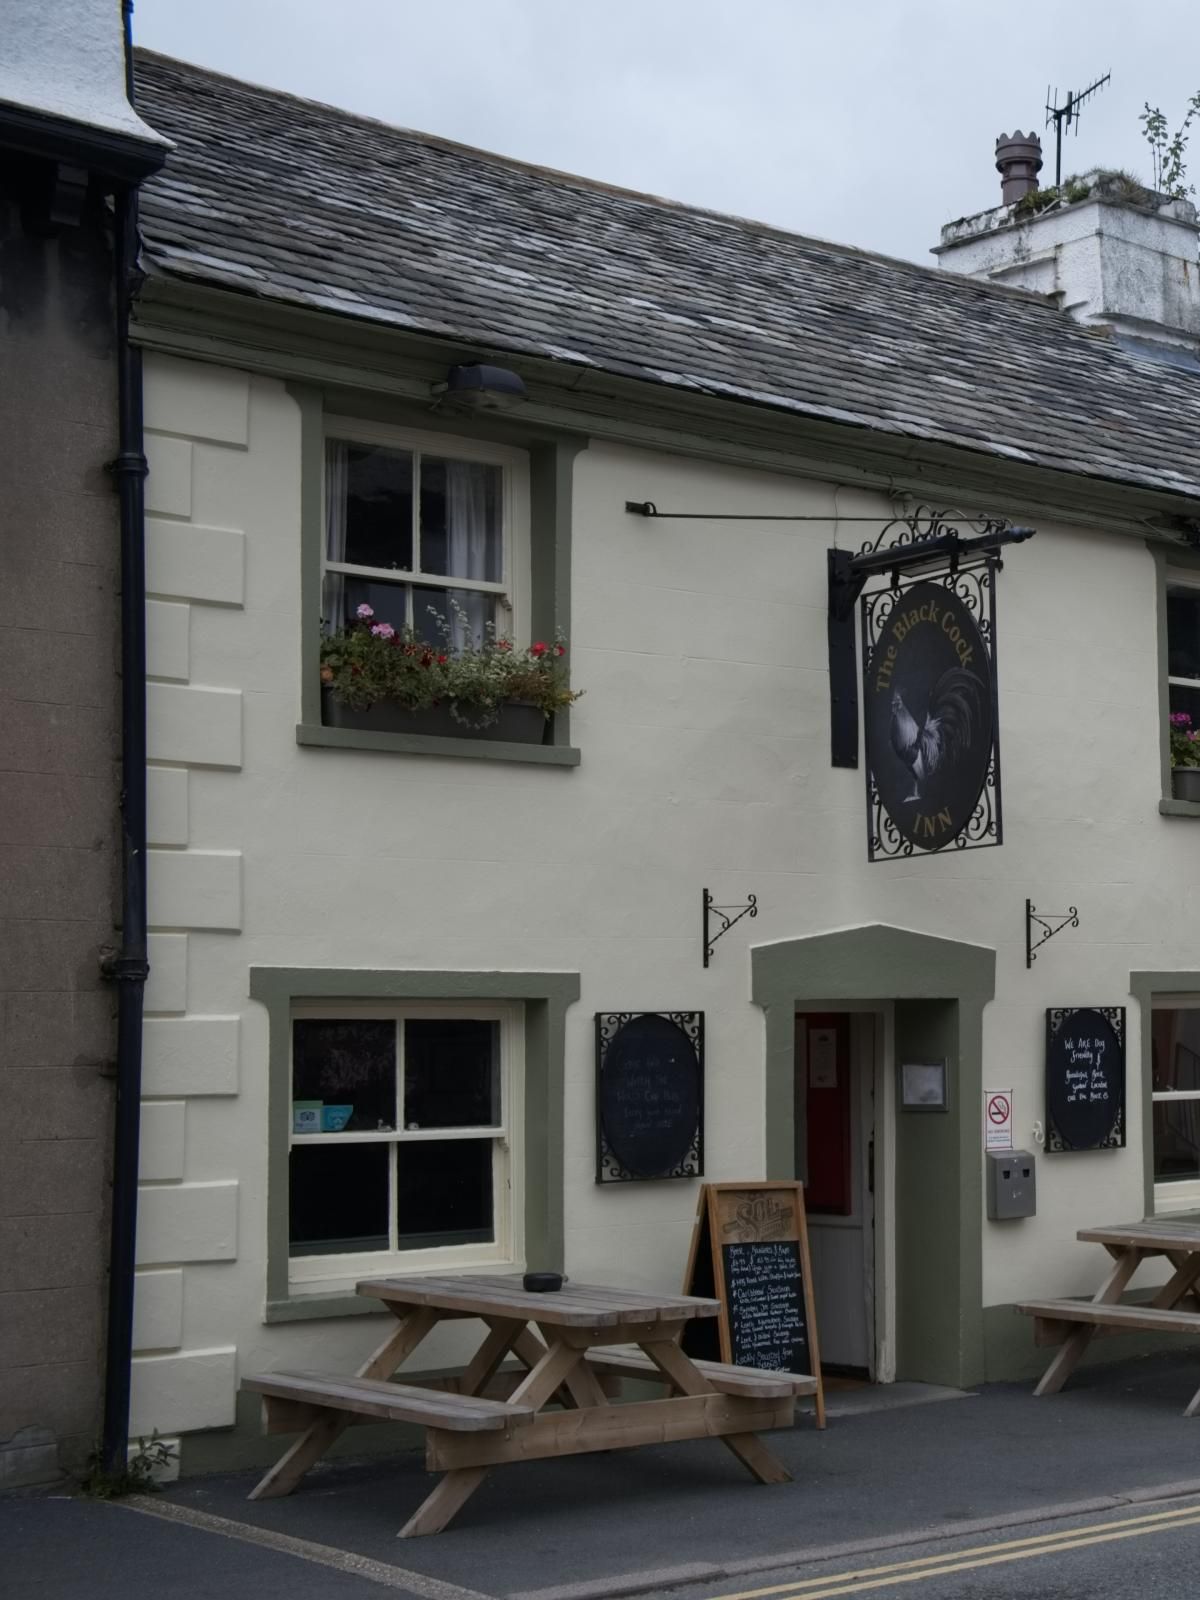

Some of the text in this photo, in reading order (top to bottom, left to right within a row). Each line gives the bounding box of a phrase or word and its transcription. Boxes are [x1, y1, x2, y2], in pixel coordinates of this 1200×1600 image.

[875, 599, 974, 692] The Black Cock
[912, 806, 954, 838] INN
[1078, 1037, 1090, 1049] ARE
[1094, 1038, 1105, 1053] Dog
